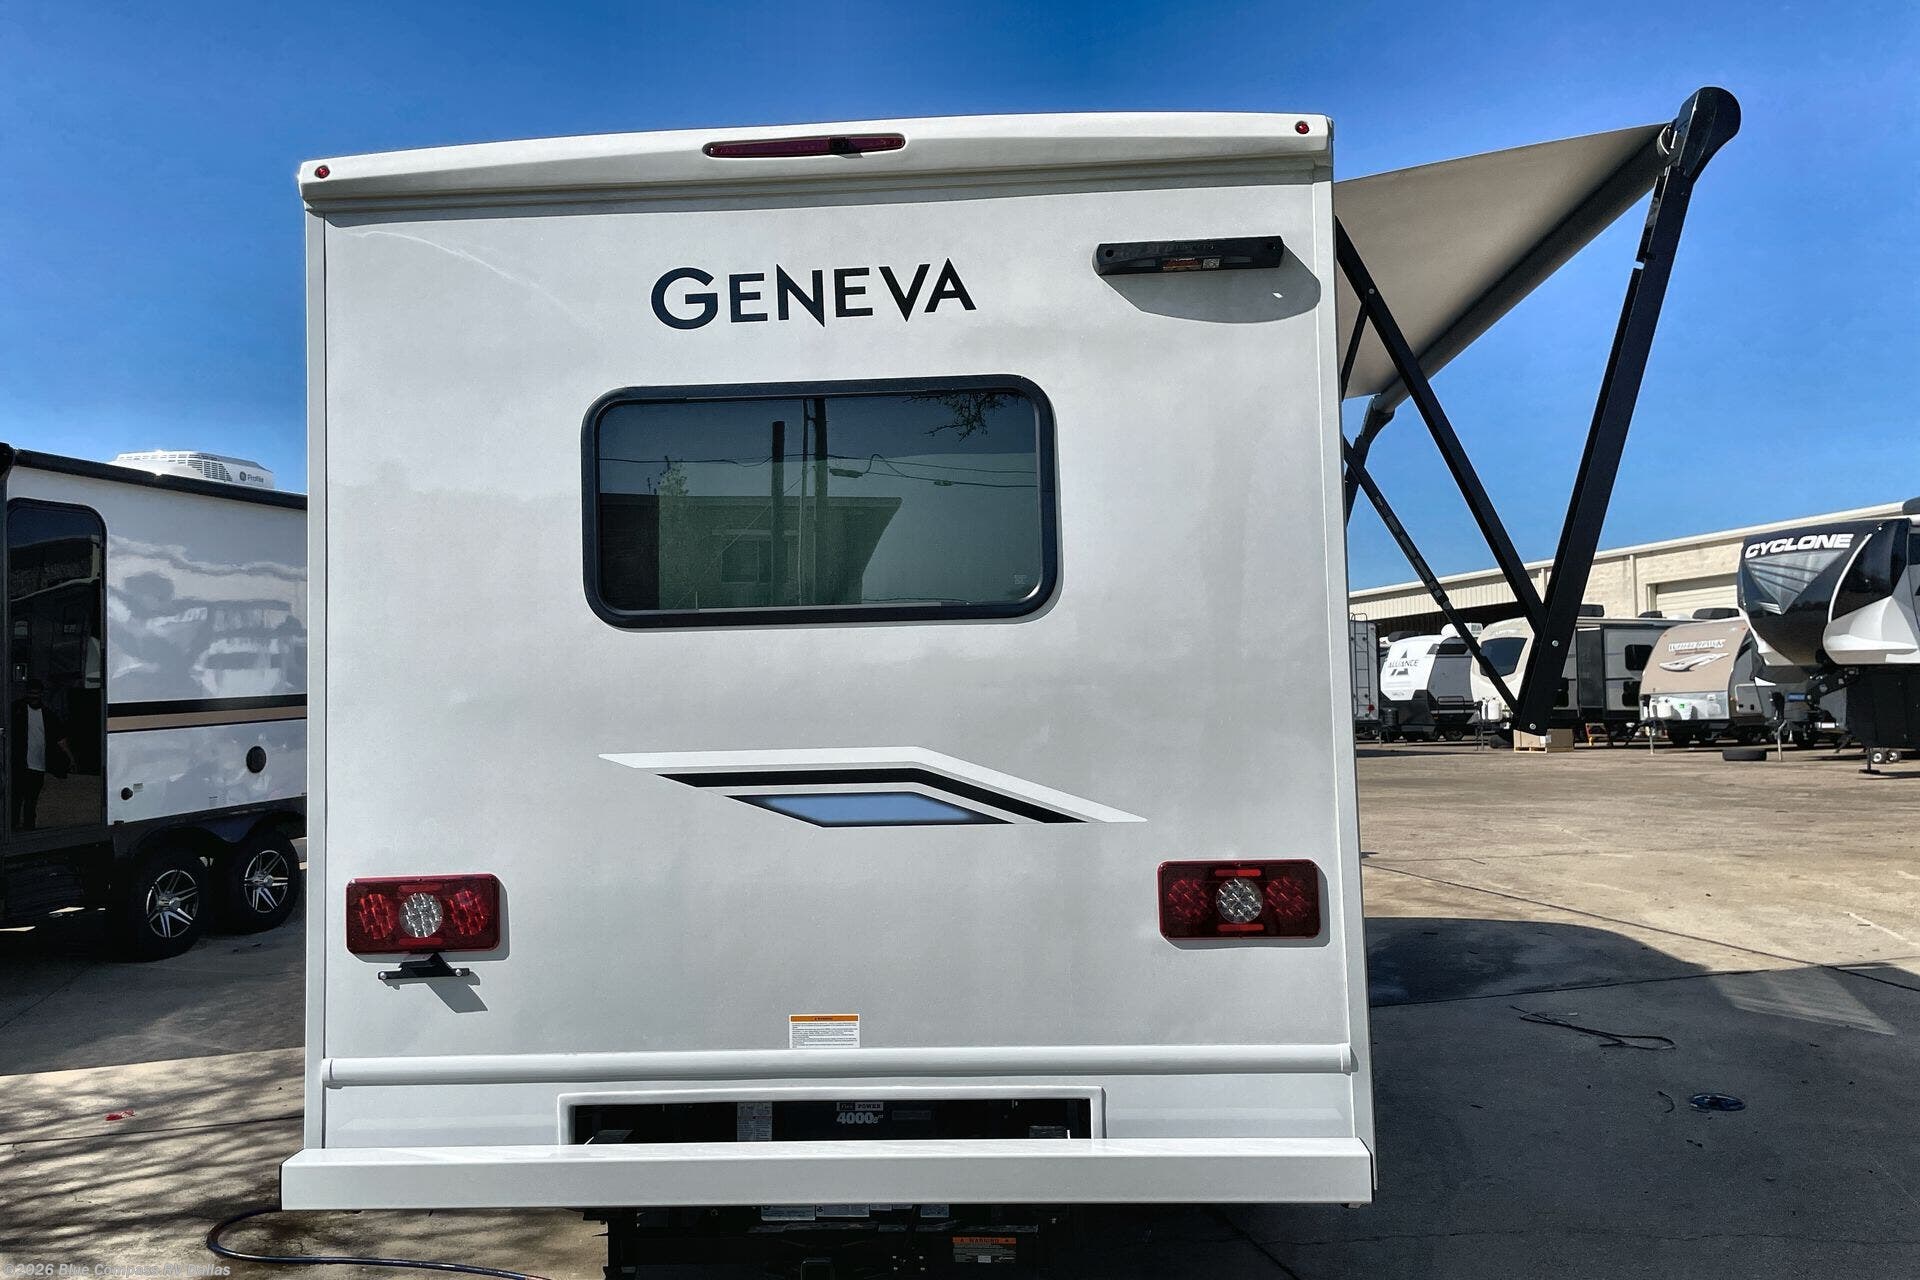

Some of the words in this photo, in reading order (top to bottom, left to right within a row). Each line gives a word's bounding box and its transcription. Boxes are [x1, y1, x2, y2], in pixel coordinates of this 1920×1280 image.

[651, 257, 977, 330] GENEVA
[1745, 533, 1854, 558] CYCLONE
[1388, 659, 1419, 668] ALLIANCE
